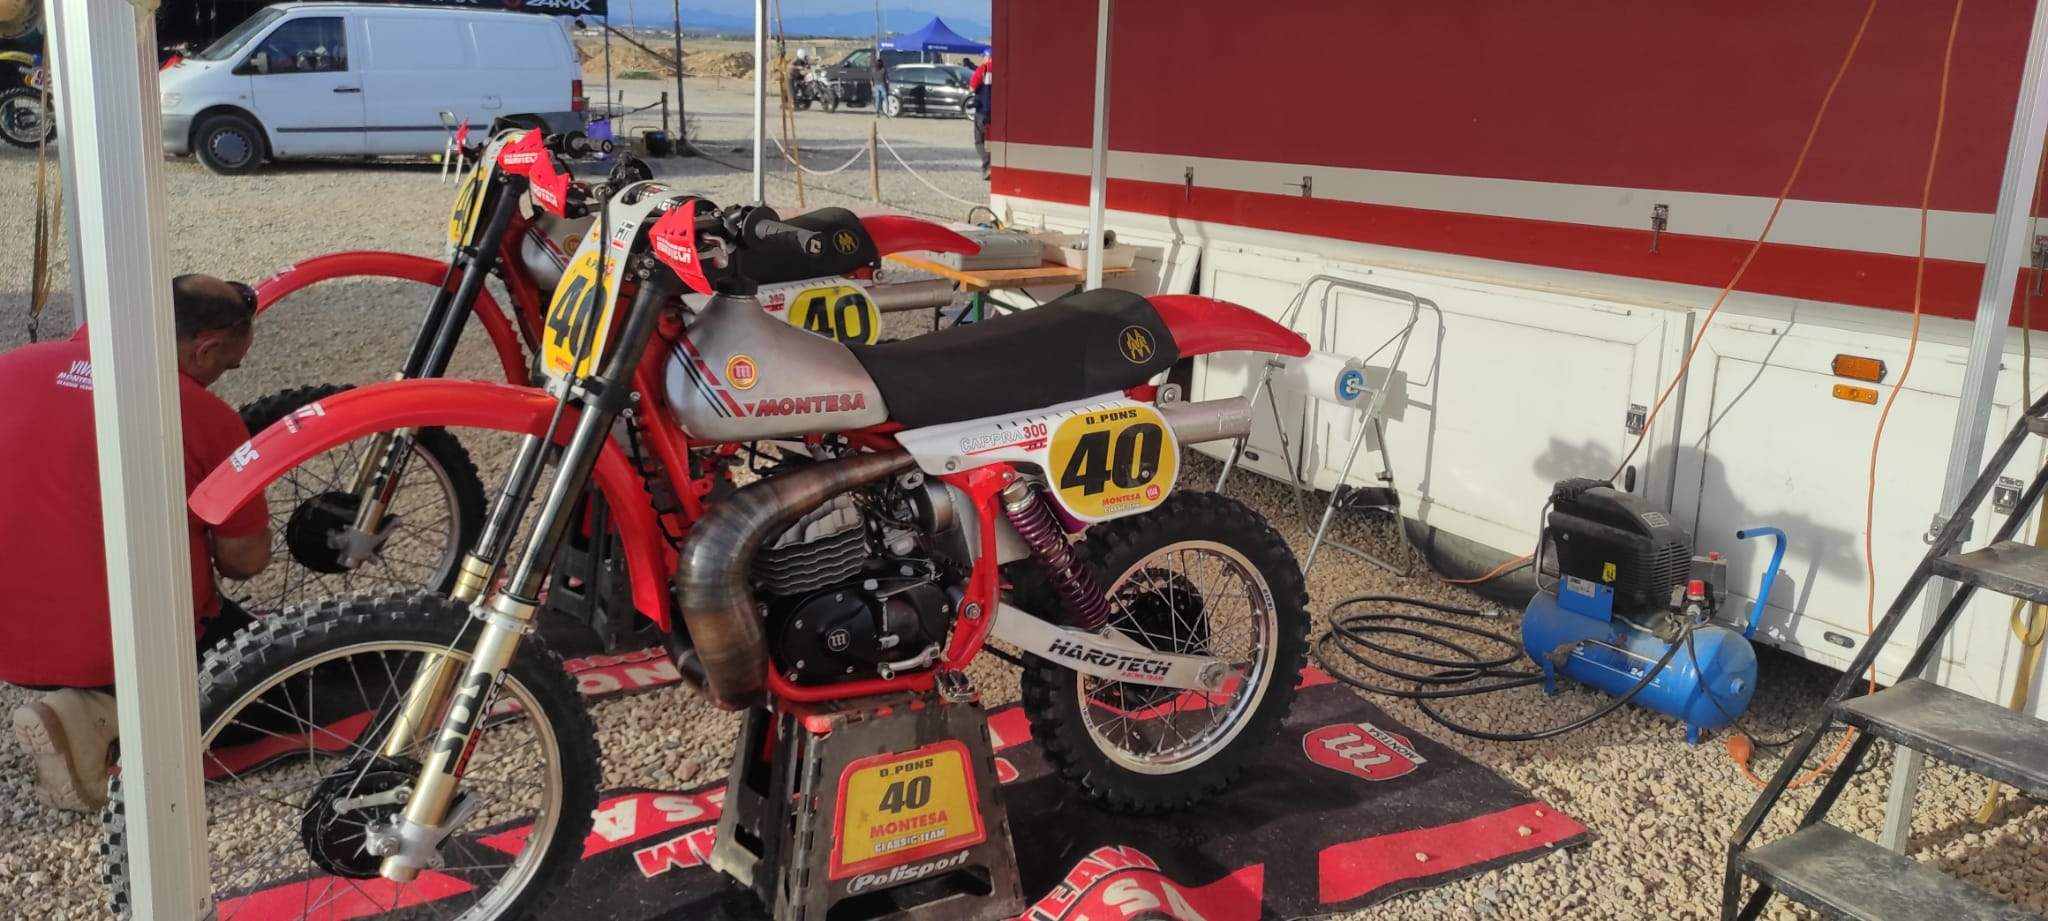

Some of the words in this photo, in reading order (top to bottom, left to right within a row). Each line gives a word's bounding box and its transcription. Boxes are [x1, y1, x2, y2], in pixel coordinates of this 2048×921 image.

[548, 275, 607, 360] 40
[803, 293, 871, 344] 40
[755, 393, 866, 417] MONTESA
[960, 430, 1023, 453] CAPPRA
[1023, 423, 1048, 439] 300
[1061, 423, 1162, 496] 40
[1103, 493, 1140, 505] MONTESA
[1049, 639, 1172, 675] HARDTECH
[1368, 727, 1419, 760] MONTESA
[879, 776, 931, 814] 40
[870, 811, 948, 838] MONTESA
[874, 834, 918, 853] CLASSIC
[920, 829, 945, 842] TEAM
[848, 850, 970, 893] Polisport
